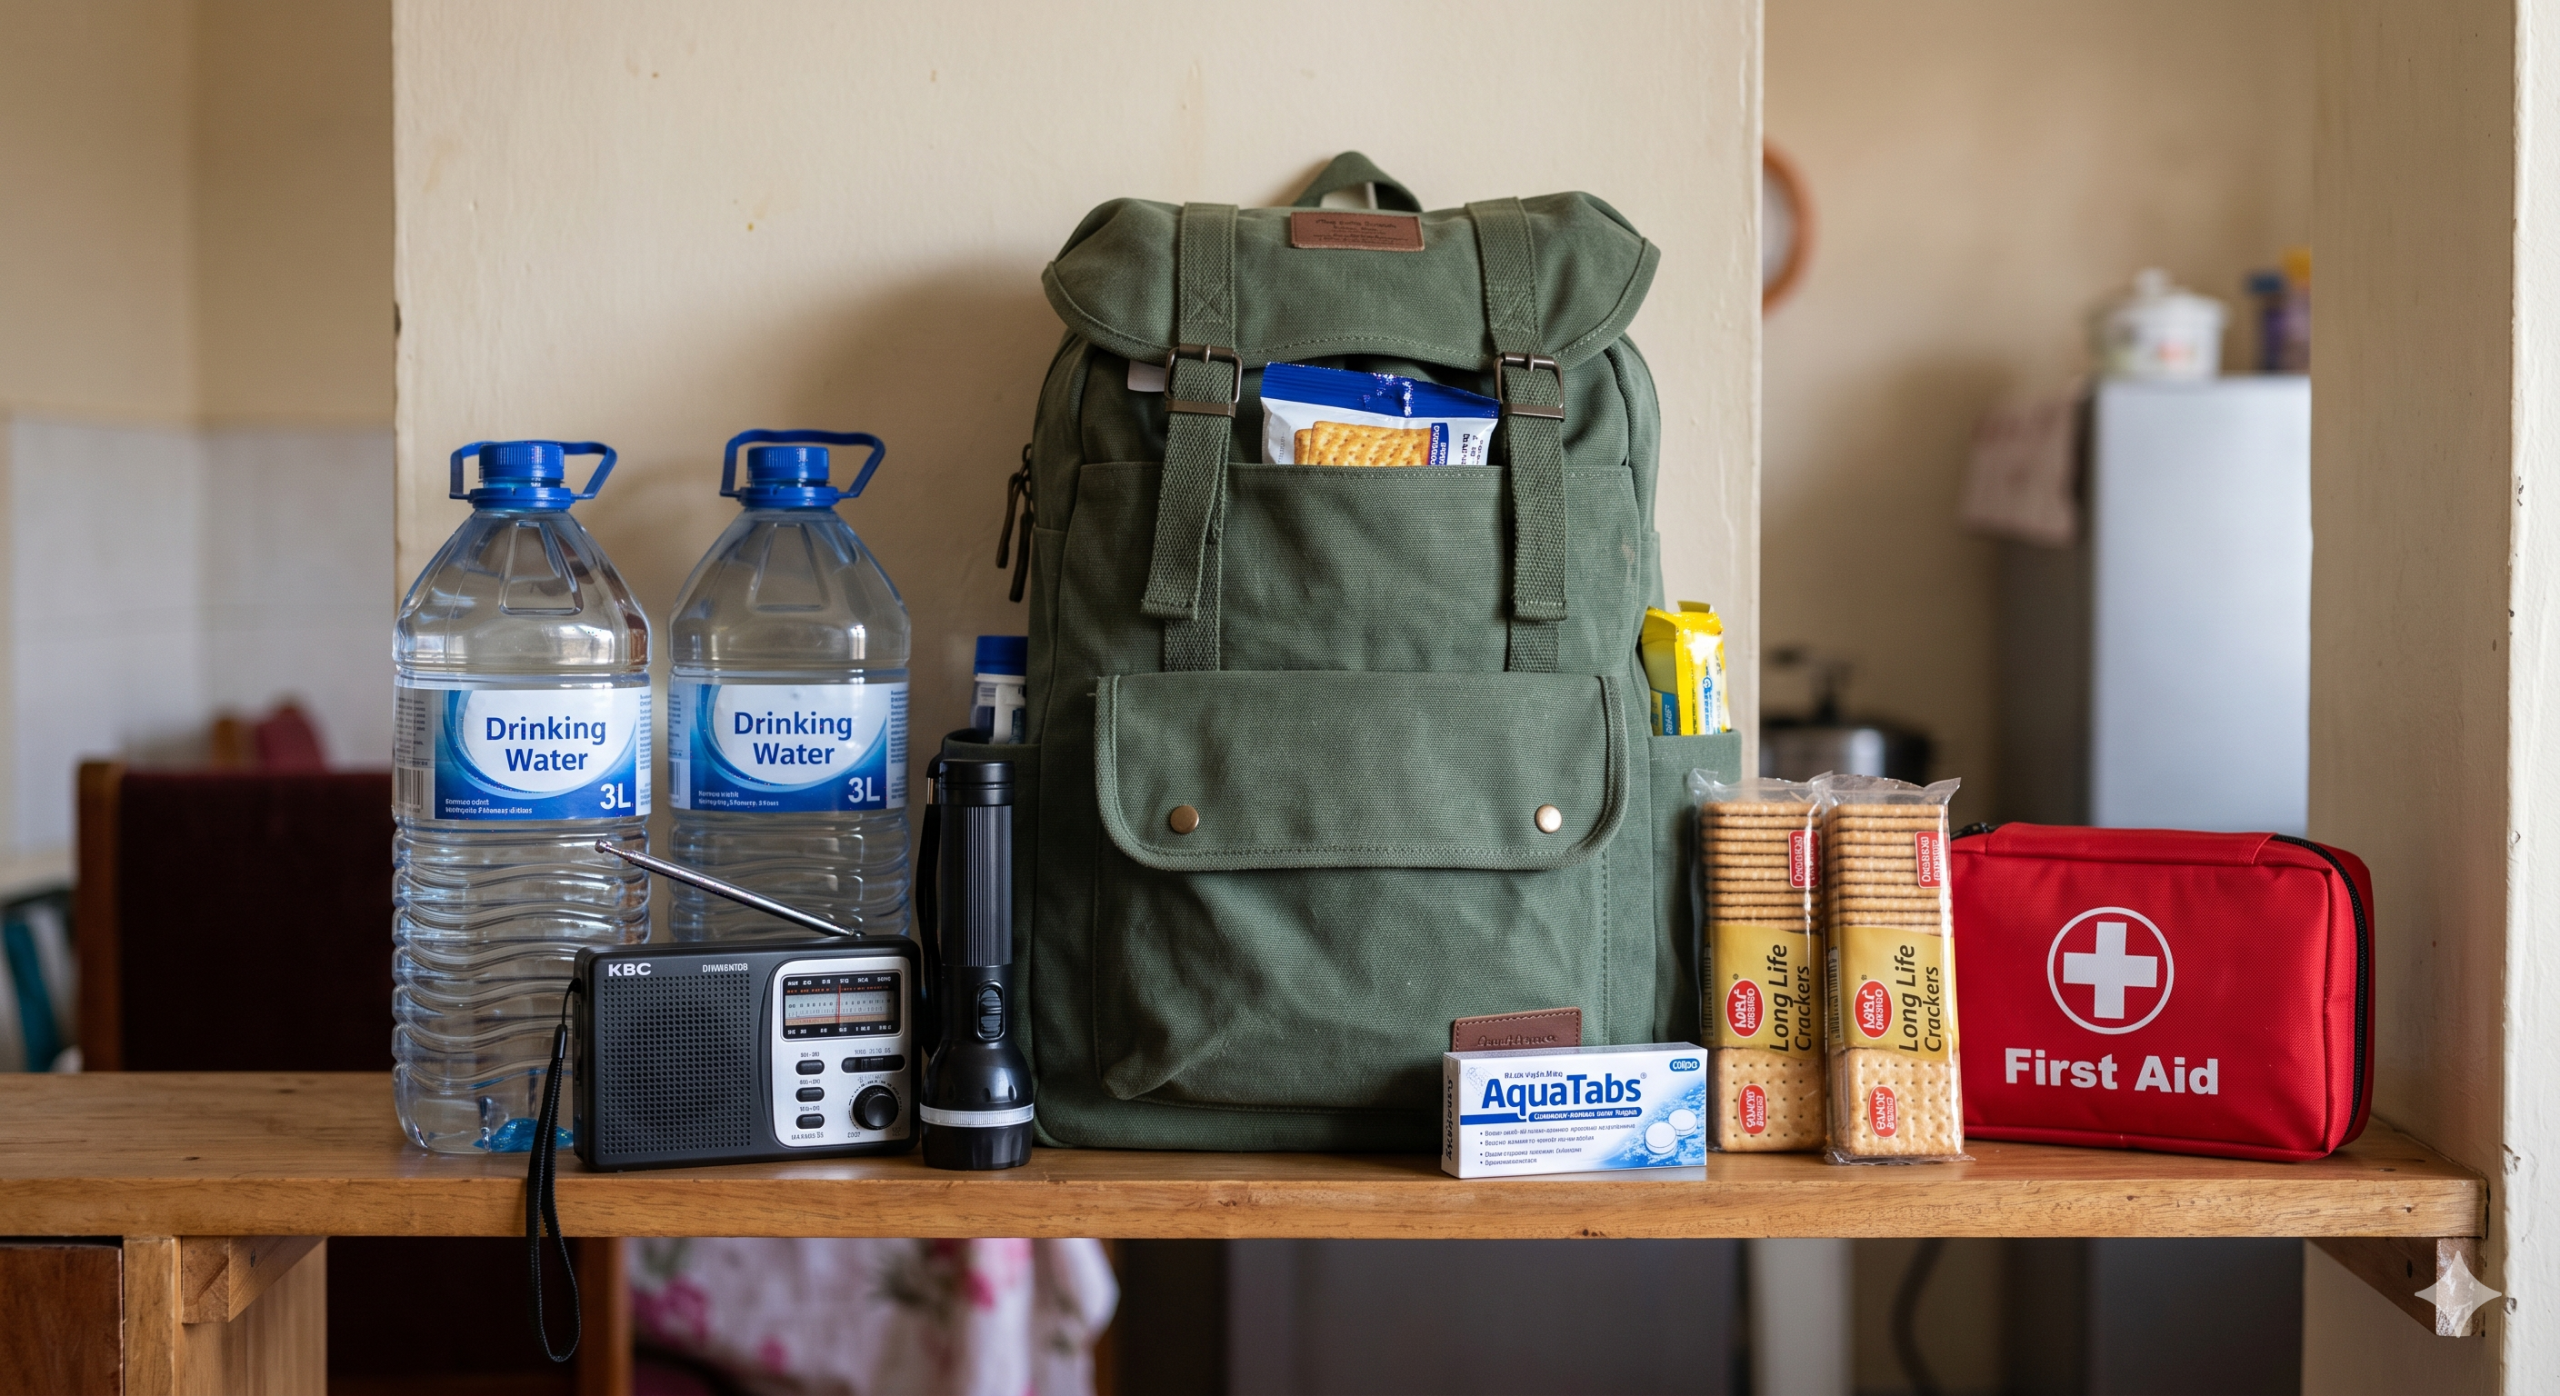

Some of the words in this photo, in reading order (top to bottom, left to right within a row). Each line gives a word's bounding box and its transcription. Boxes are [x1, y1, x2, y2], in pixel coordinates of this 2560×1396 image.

[486, 716, 607, 745] Drinking
[733, 711, 853, 740] Drinking
[505, 747, 589, 772] Water
[753, 742, 835, 766] Water
[600, 783, 632, 811] 3L
[848, 777, 880, 803] 3L
[608, 962, 652, 977] KBC
[1766, 945, 1788, 988] Life
[1894, 945, 1916, 988] Life
[1770, 993, 1793, 1052] Long
[1793, 966, 1812, 1052] Crackers
[1899, 993, 1922, 1052] Long
[1922, 967, 1942, 1053] Crackers
[2005, 1048, 2119, 1091] First
[2134, 1055, 2219, 1096] Aid
[1481, 1073, 1642, 1117] AquaTabs
